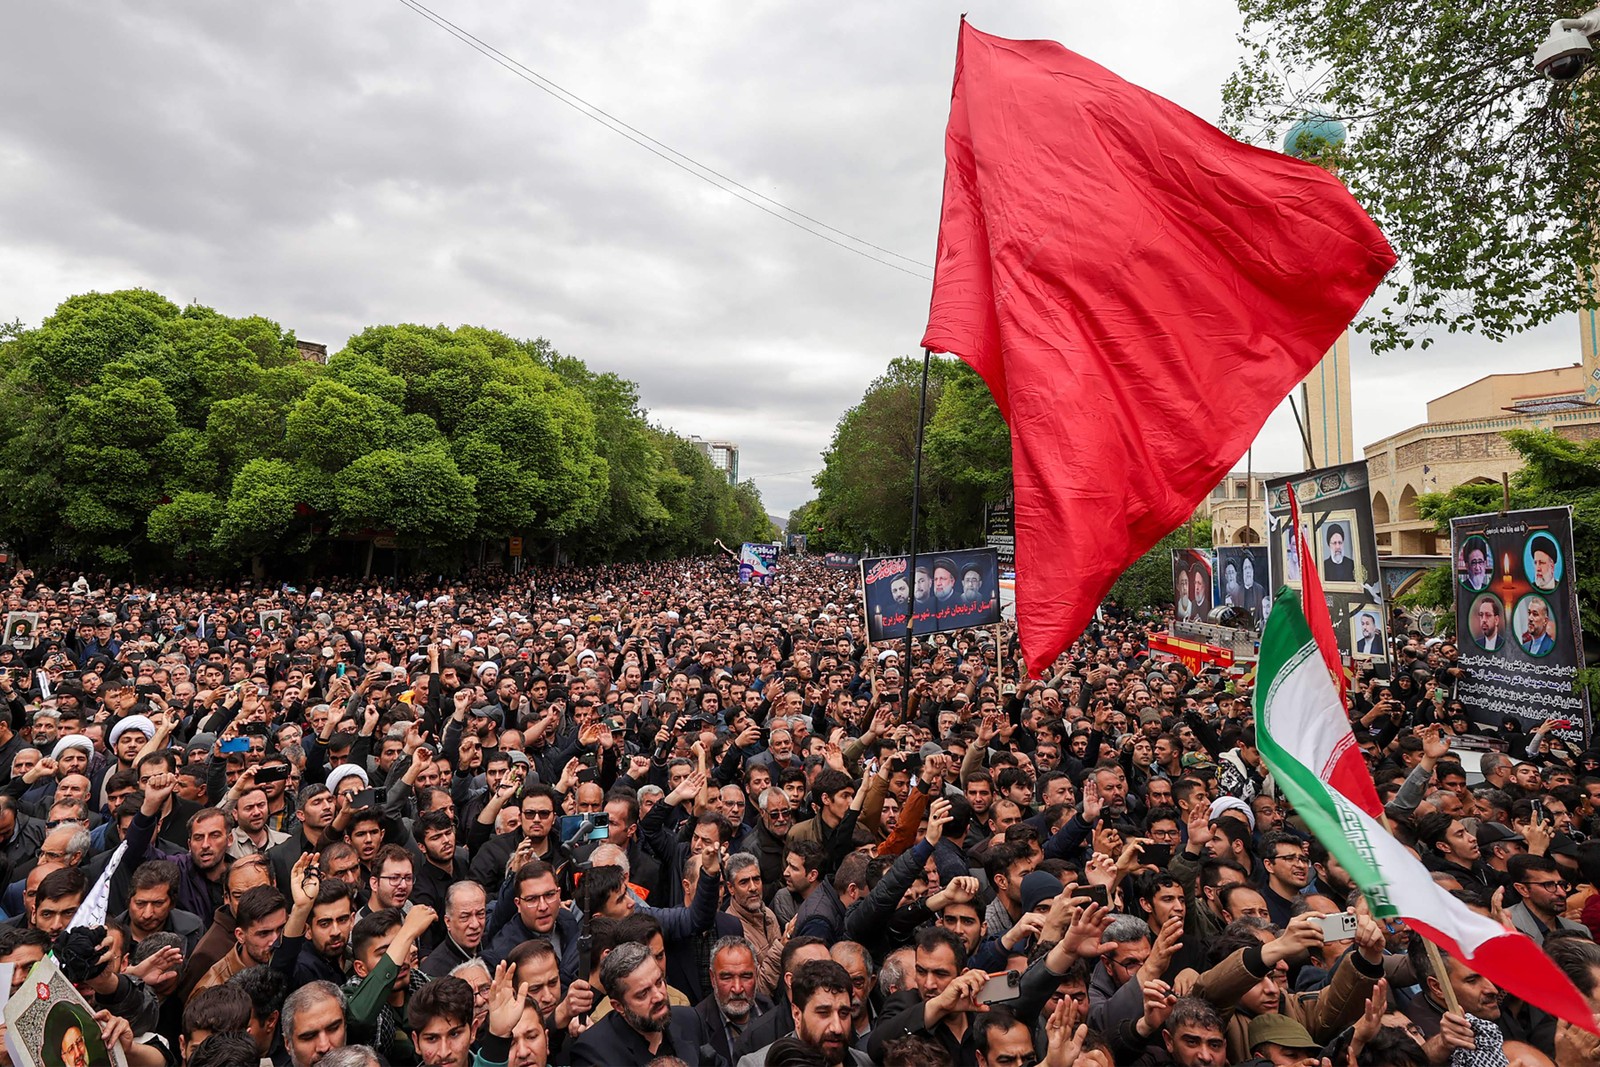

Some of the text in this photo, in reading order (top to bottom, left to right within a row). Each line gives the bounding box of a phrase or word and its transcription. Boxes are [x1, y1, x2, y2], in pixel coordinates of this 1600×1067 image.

[951, 601, 977, 617] آذربایجان
[978, 600, 992, 613] استان
[936, 607, 951, 619] غربی
[1546, 680, 1561, 691] جمعه
